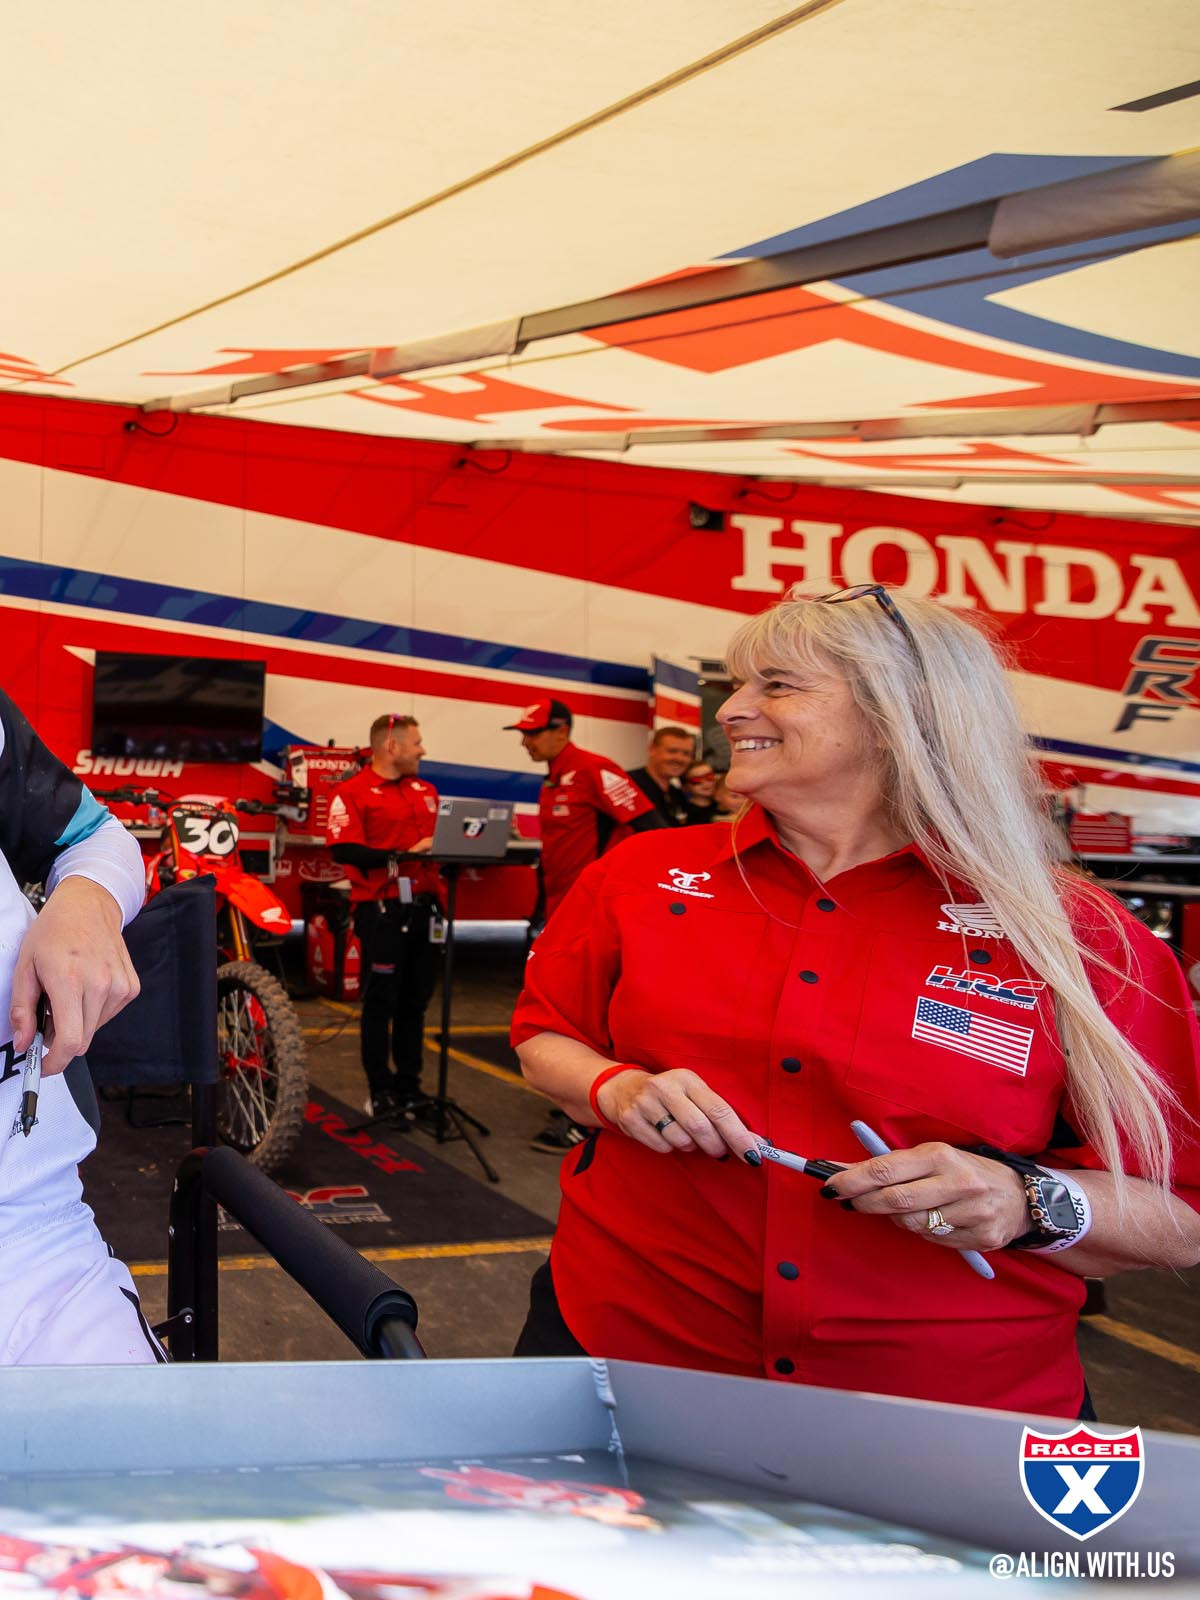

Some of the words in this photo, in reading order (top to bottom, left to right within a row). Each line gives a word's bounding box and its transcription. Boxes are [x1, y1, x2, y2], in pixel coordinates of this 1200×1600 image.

[729, 513, 1200, 629] HONDA
[180, 817, 240, 855] 30
[936, 920, 1010, 939] HON
[925, 965, 1047, 1005] HRC
[979, 993, 1035, 1010] RACING
